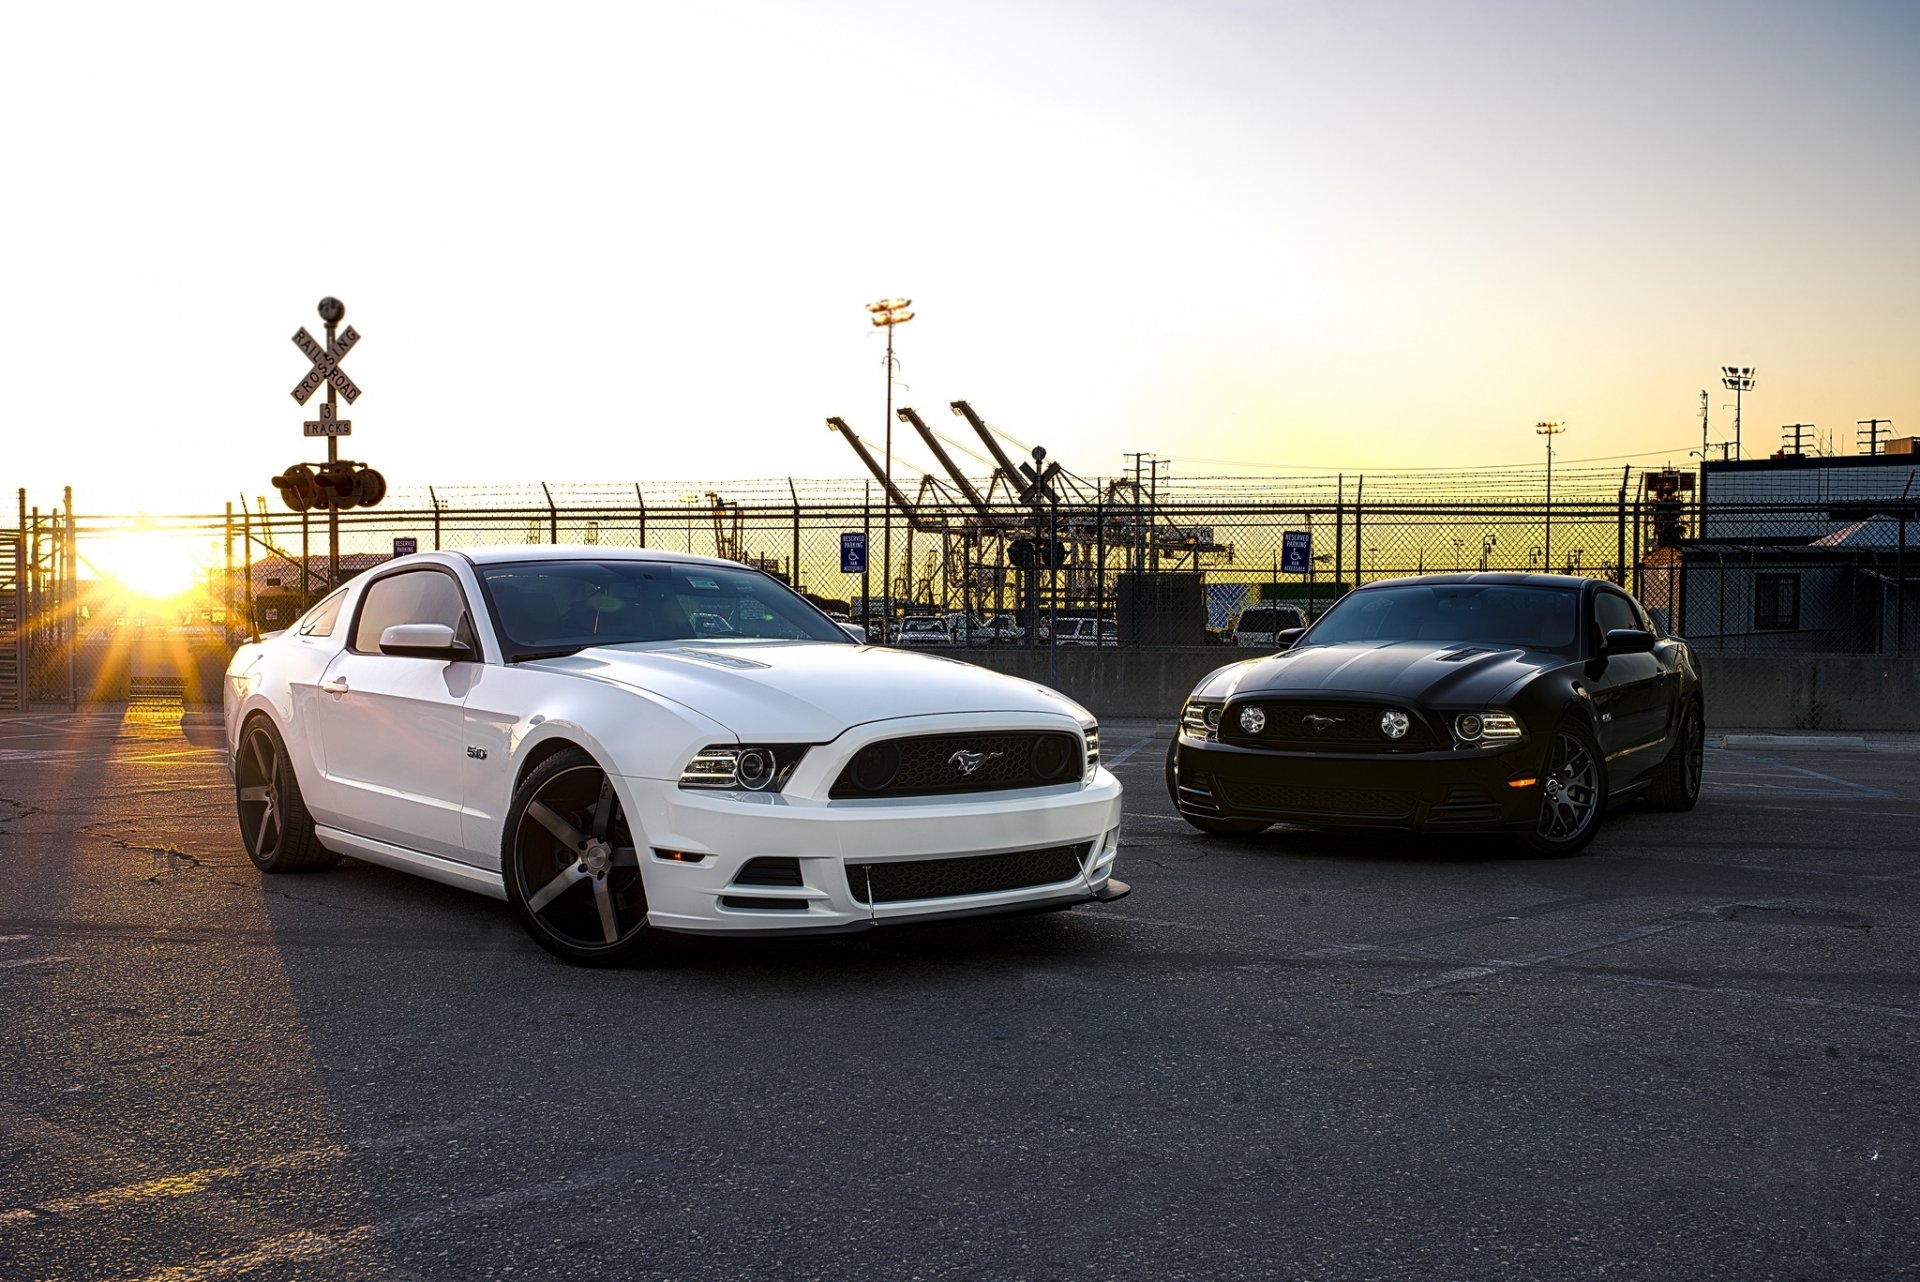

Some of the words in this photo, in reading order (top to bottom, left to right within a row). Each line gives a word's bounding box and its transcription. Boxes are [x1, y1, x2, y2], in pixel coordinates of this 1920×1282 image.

[294, 329, 356, 401] CROSSING
[323, 407, 331, 419] 3
[305, 423, 350, 433] TRACKS
[1285, 533, 1309, 541] RESERVED
[1286, 540, 1307, 548] PARKING
